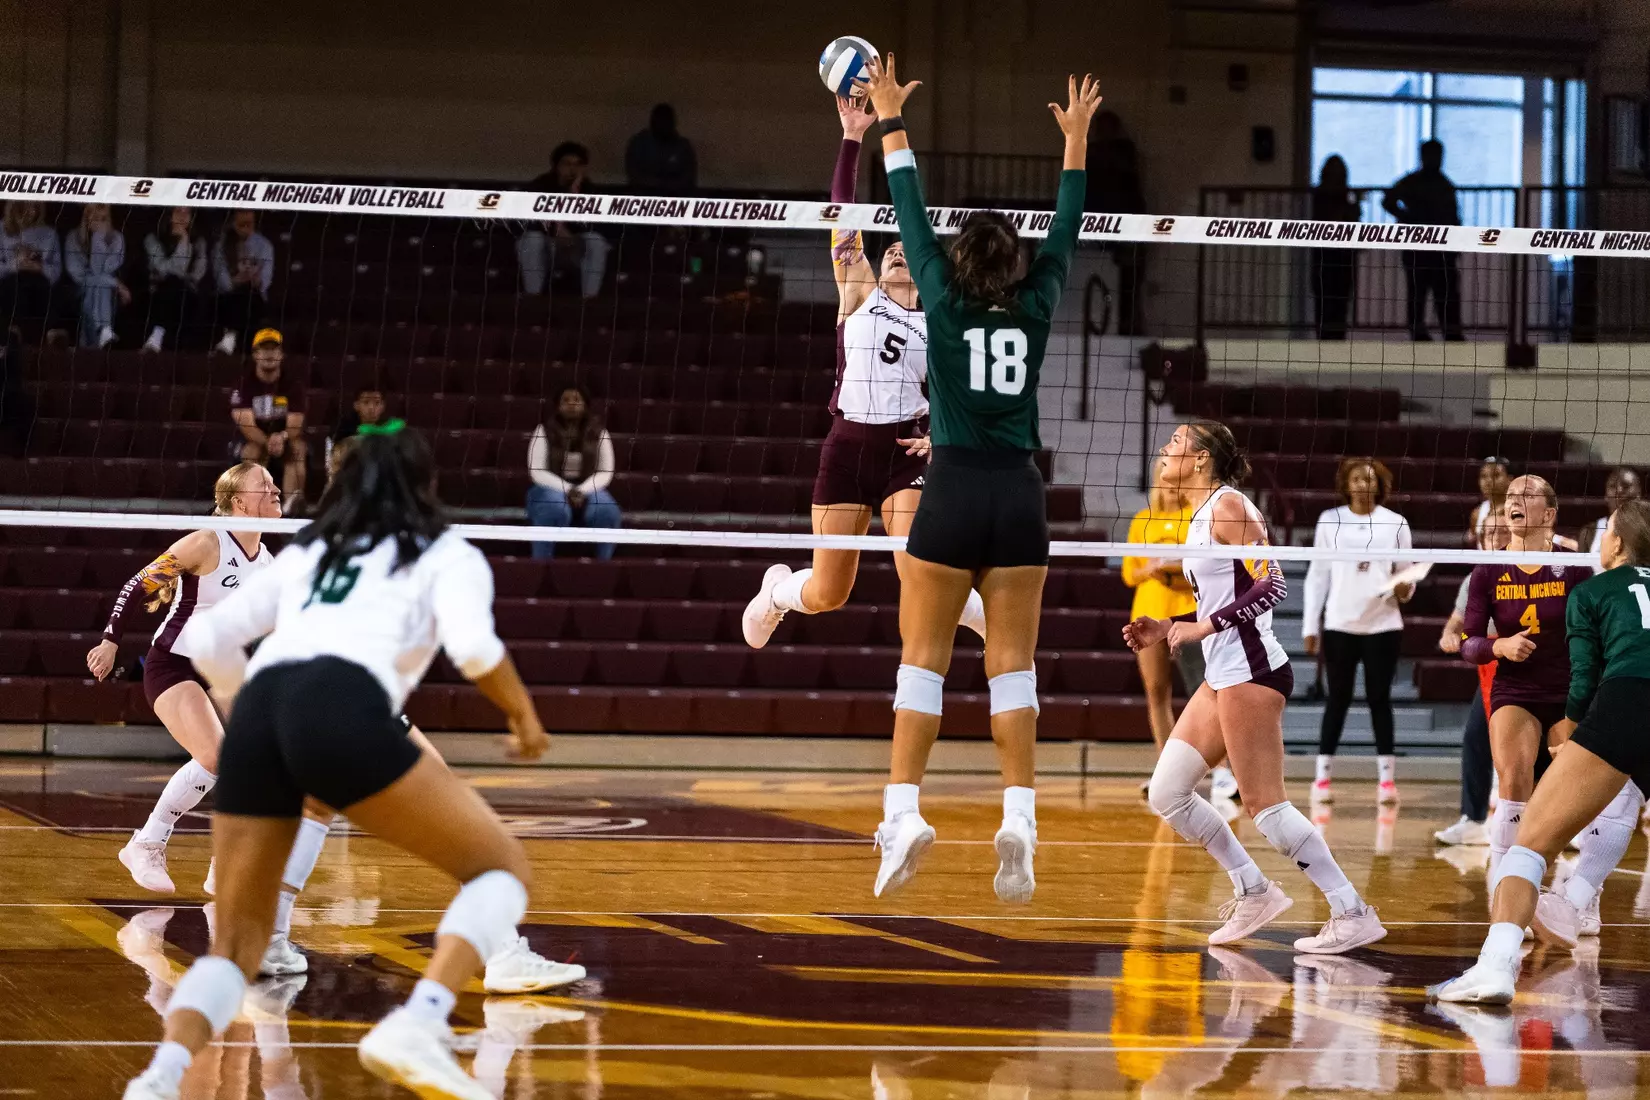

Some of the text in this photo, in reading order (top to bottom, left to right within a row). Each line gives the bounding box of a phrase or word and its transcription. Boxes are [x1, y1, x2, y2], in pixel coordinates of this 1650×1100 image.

[0, 174, 97, 196] VOLLEYBALL
[186, 181, 446, 209] CENTRAL MICHIGAN VOLLEYBALL
[533, 195, 788, 221] CENTRAL MICHIGAN VOLLEYBALL
[1205, 219, 1449, 244] CENTRAL MICHIGAN VOLLEYBALL
[1530, 230, 1596, 249] CENTRAL
[879, 332, 907, 365] 5
[963, 327, 1028, 396] 18
[1236, 567, 1288, 623] CHIPPEWAS
[1496, 581, 1566, 600] CENTRAL MICHIGAN
[1519, 603, 1540, 635] 4
